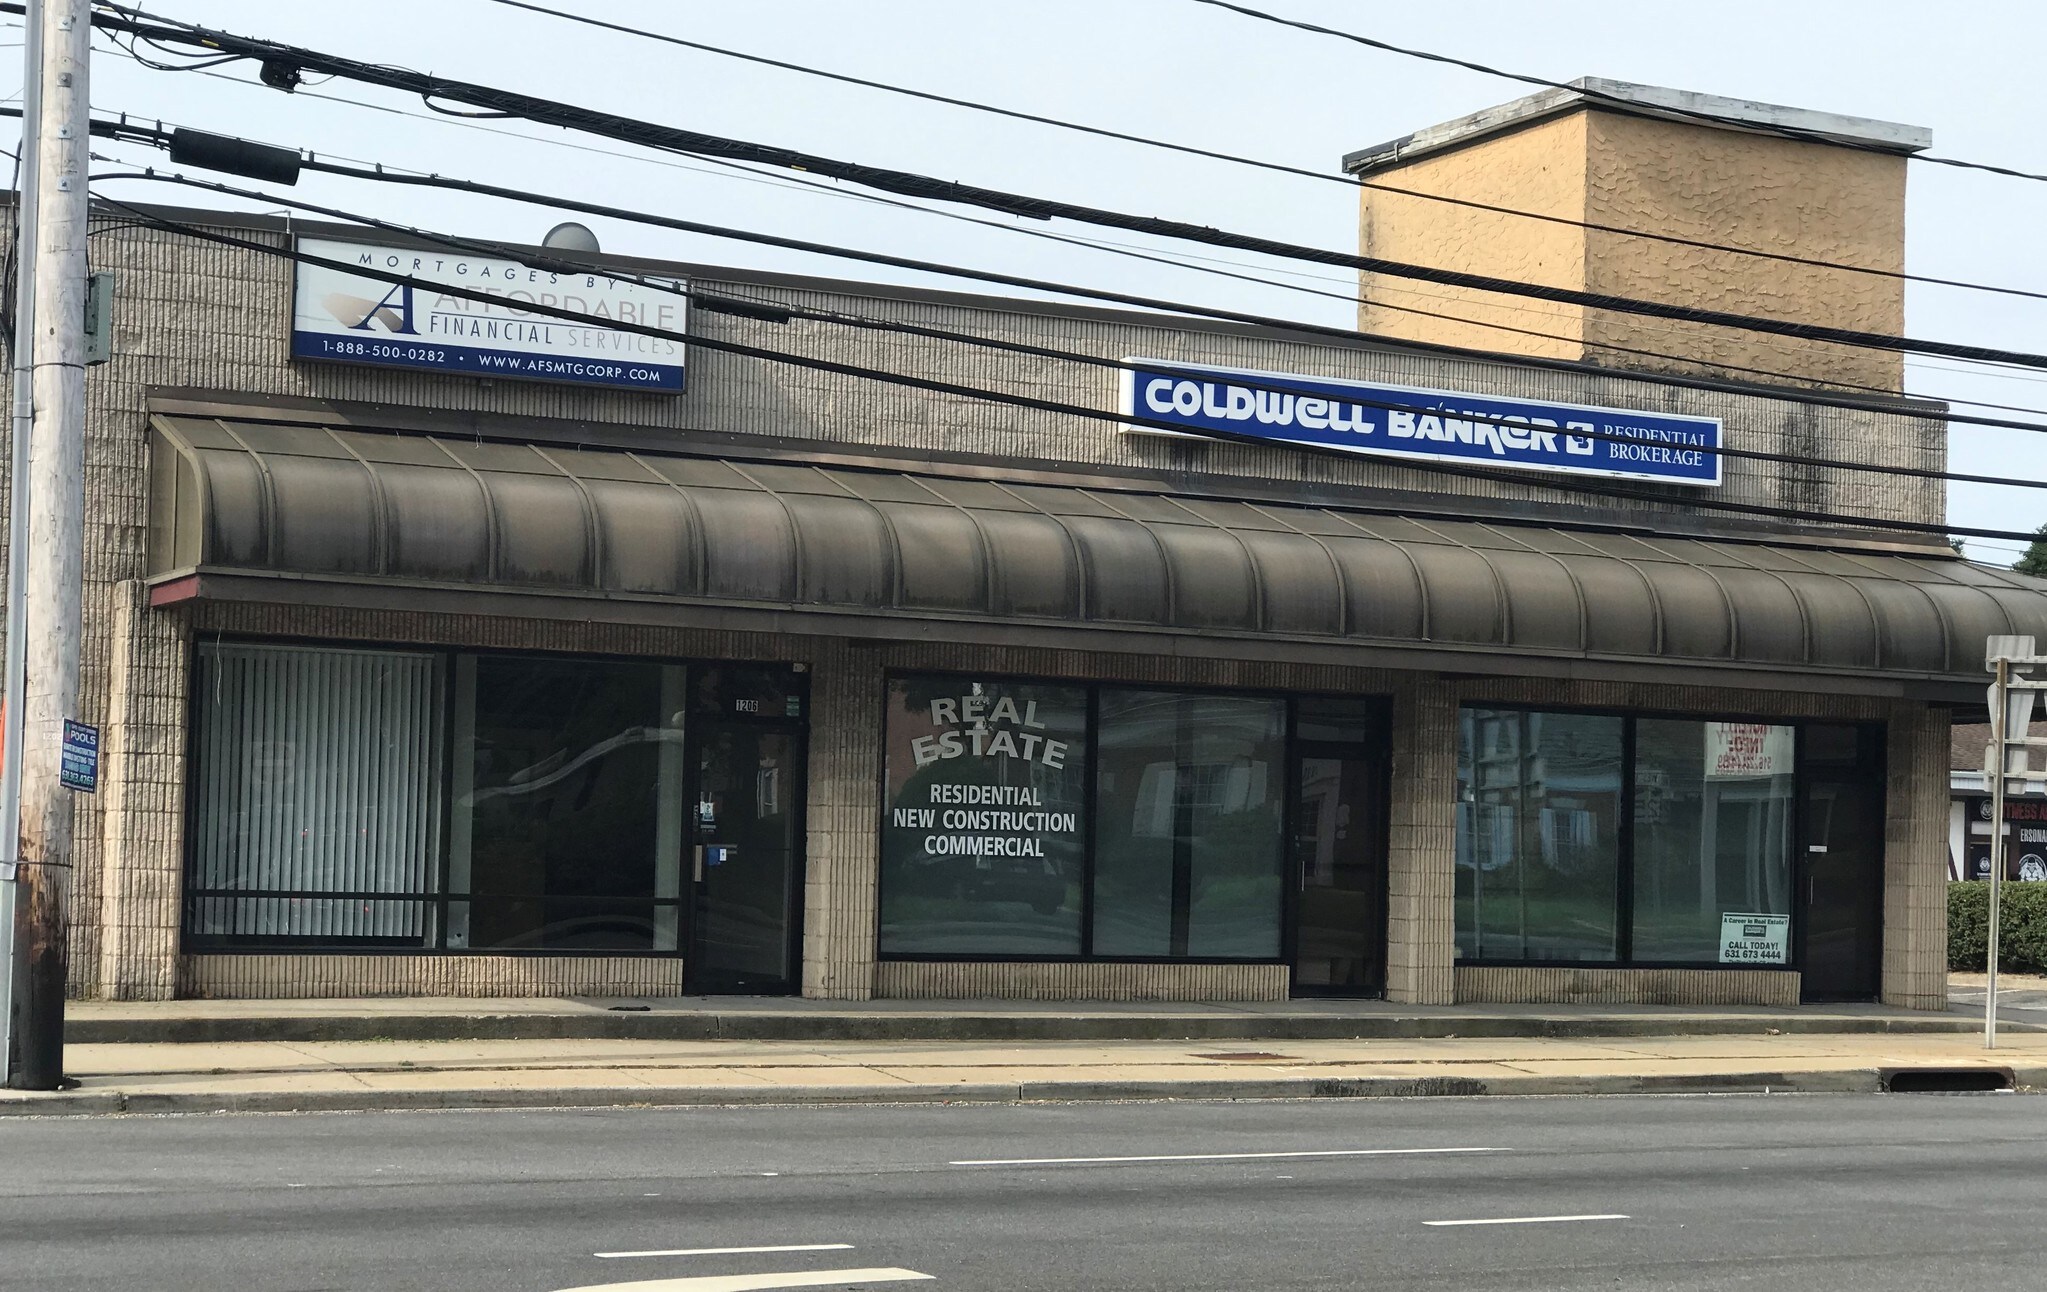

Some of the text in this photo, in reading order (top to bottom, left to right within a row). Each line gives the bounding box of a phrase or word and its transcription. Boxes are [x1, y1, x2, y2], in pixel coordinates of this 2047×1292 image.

[358, 253, 558, 285] MORTGAGES
[433, 282, 675, 331] AFFORDABLE
[429, 314, 675, 355] FINANCIAL SERVICES
[322, 339, 661, 382] 1-888-500-0282 WWW.AFSMTGCORP.COM
[1145, 378, 1375, 434] COLDWELL
[1387, 403, 1559, 455] BANKER
[1609, 442, 1704, 467] BROKERAGE
[736, 700, 758, 712] 1206
[930, 695, 1046, 730] REAL
[70, 730, 97, 745] POOLS
[911, 729, 1069, 770] ESTATE
[929, 783, 1042, 807] RESIDENTIAL
[893, 808, 1076, 833] NEW CONSTRUCTION
[924, 835, 1045, 858] COMMERCIAL
[1724, 949, 1781, 959] 631 673 4444
[1728, 941, 1779, 950] CALL TODAY!
